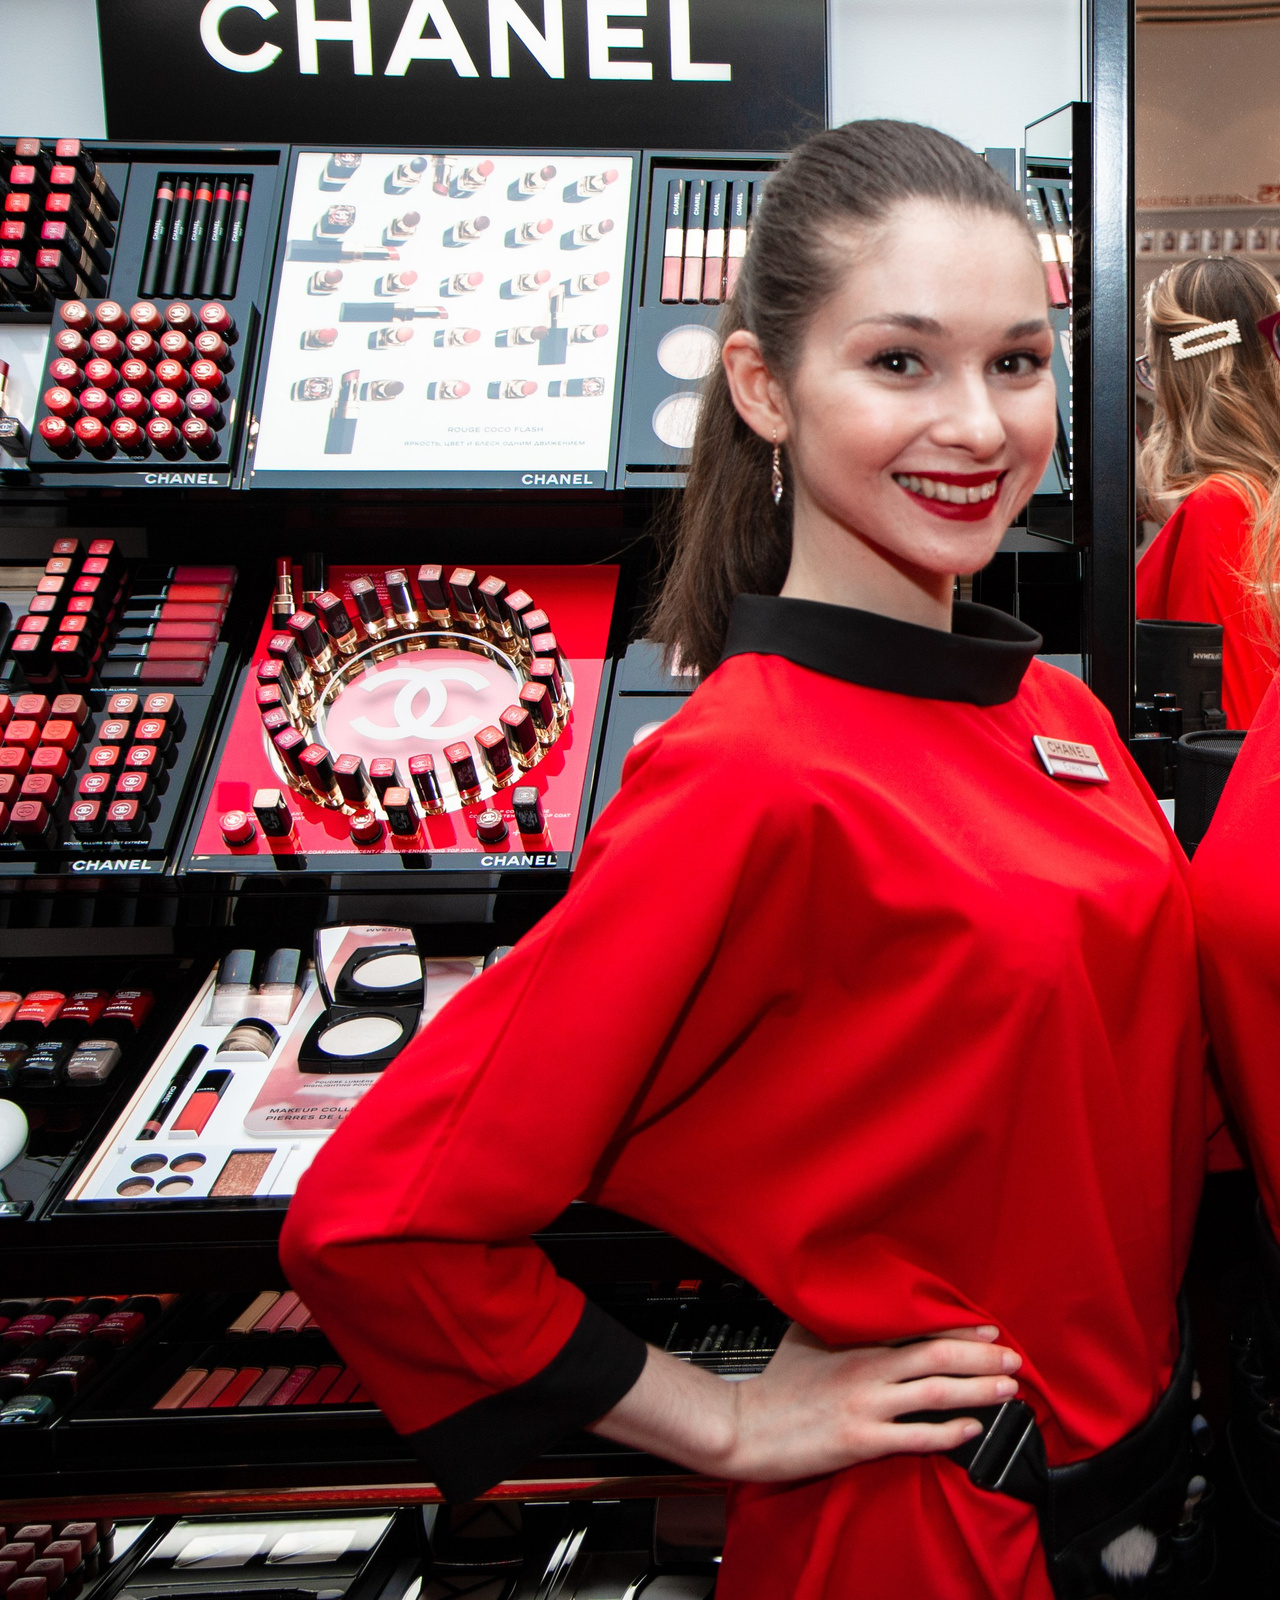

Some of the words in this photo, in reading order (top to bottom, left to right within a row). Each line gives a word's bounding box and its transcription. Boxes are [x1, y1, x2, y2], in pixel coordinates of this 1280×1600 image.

[200, 0, 732, 81] CHANEL
[144, 473, 219, 485] CHANEL
[521, 473, 593, 485] CHANEL
[1047, 741, 1090, 759] CHANEL
[72, 859, 152, 871] CHANEL
[481, 855, 558, 867] CHANEL
